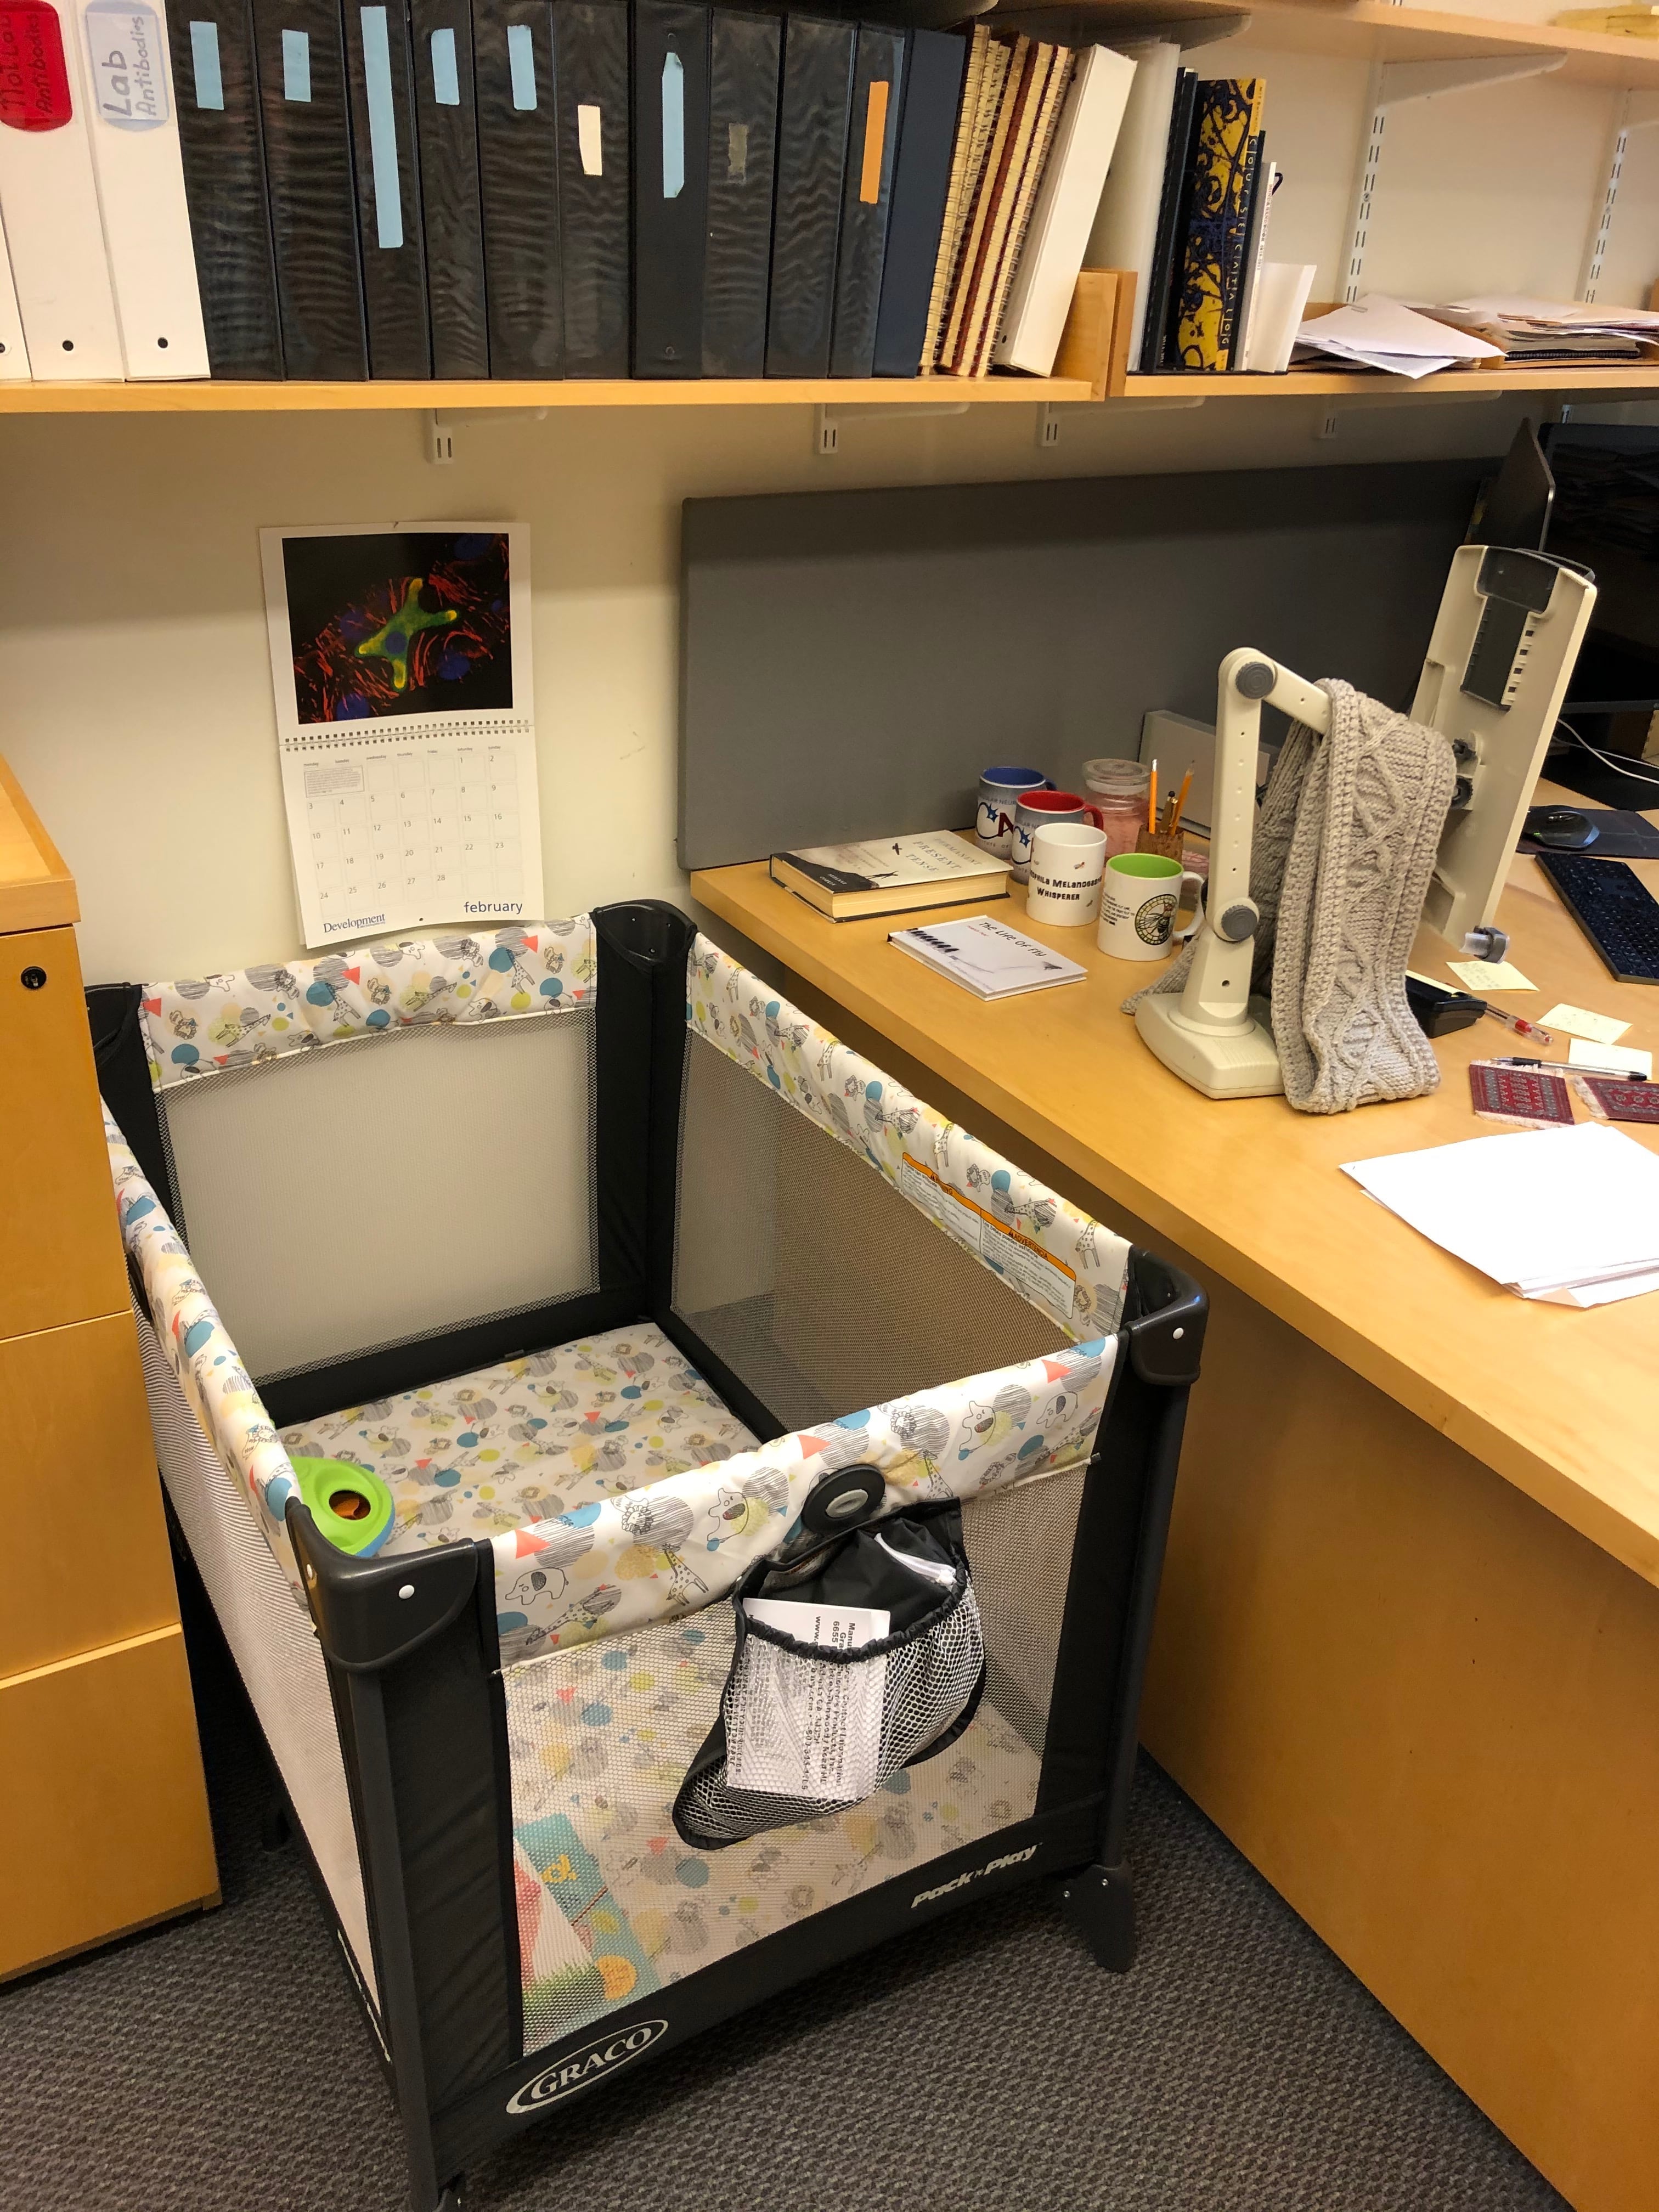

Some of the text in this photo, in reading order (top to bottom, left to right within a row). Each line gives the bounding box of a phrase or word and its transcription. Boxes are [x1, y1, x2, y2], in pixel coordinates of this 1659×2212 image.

[129, 16, 157, 116] Antibodies
[101, 50, 132, 116] Lab
[905, 853, 940, 873] TENSE
[912, 840, 962, 870] PRESENT
[1036, 886, 1080, 901] WHISPERER
[463, 901, 523, 915] february
[323, 913, 386, 934] Development
[979, 922, 997, 932] The
[1013, 1234, 1048, 1261] ADVERTENCIA
[832, 1621, 840, 1643] 6655
[910, 1871, 975, 1909] Pack
[983, 1844, 1038, 1876] Play
[531, 2027, 652, 2100] GRACO
